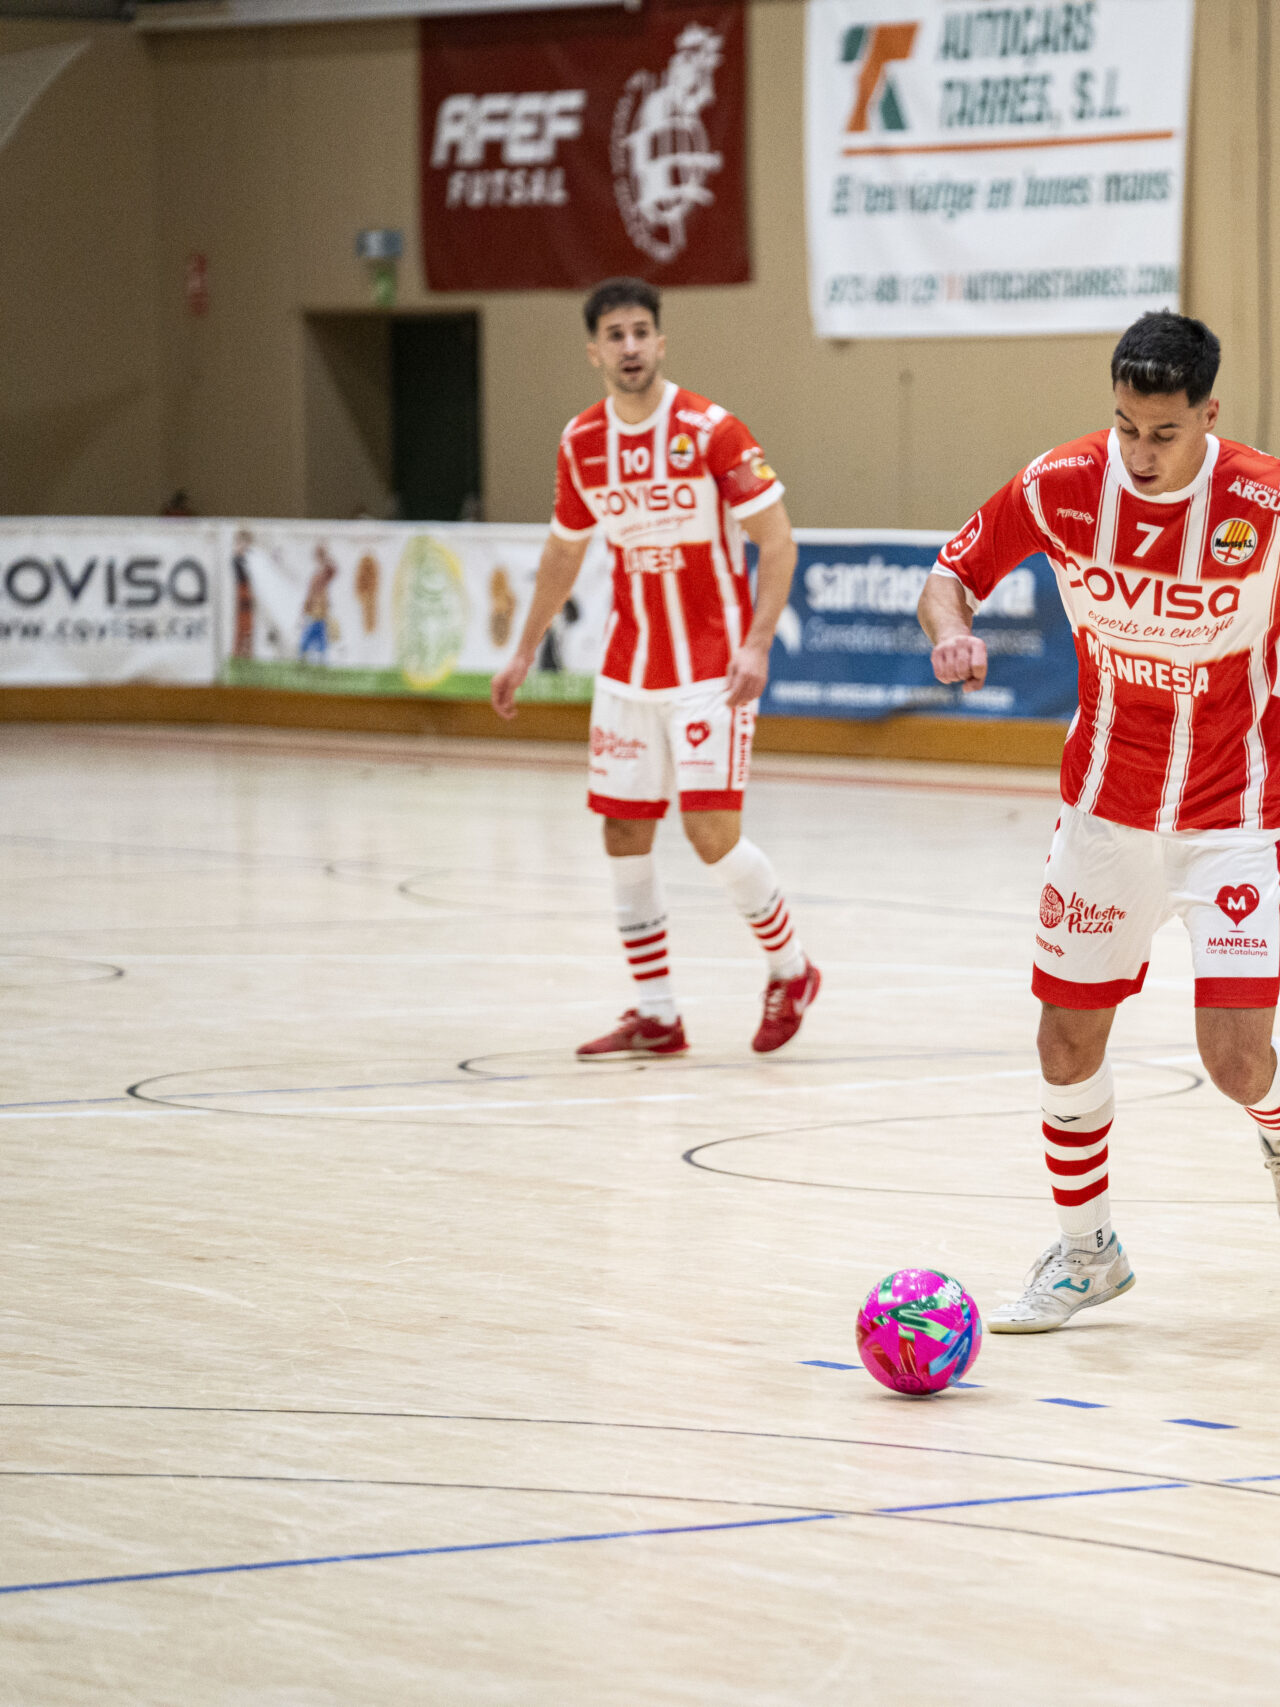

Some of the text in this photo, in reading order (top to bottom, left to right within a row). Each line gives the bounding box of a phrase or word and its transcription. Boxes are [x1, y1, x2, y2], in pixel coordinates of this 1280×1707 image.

[447, 168, 568, 207] FUTSAL
[621, 446, 650, 475] 10
[1133, 522, 1164, 557] 7
[1089, 609, 1140, 634] experts
[1143, 624, 1165, 637] en
[1086, 632, 1210, 698] MANRESA
[1067, 892, 1085, 912] La
[1227, 896, 1247, 911] M
[1064, 912, 1113, 934] Pizza
[1207, 937, 1267, 949] MANRESA
[1219, 947, 1228, 955] de
[1229, 948, 1268, 957] Catalunya
